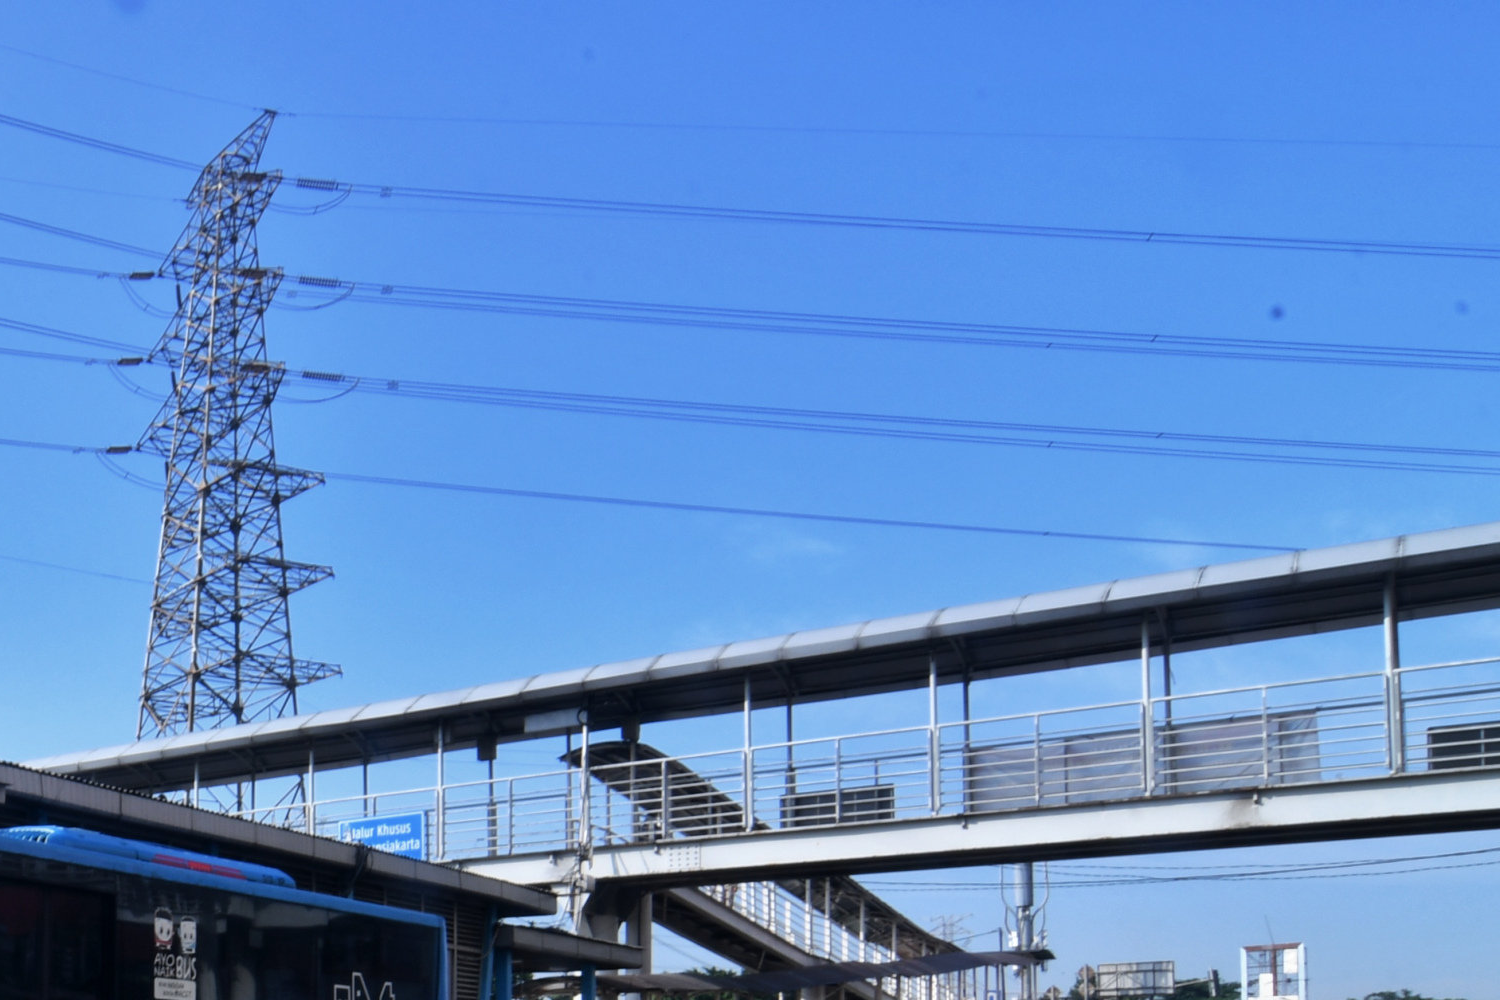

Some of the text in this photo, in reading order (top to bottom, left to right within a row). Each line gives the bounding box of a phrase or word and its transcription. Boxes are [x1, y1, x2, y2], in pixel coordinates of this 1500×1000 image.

[377, 823, 411, 836] Khusus
[154, 953, 175, 967] AYO
[154, 966, 175, 977] NAIK
[176, 956, 197, 980] BUS
